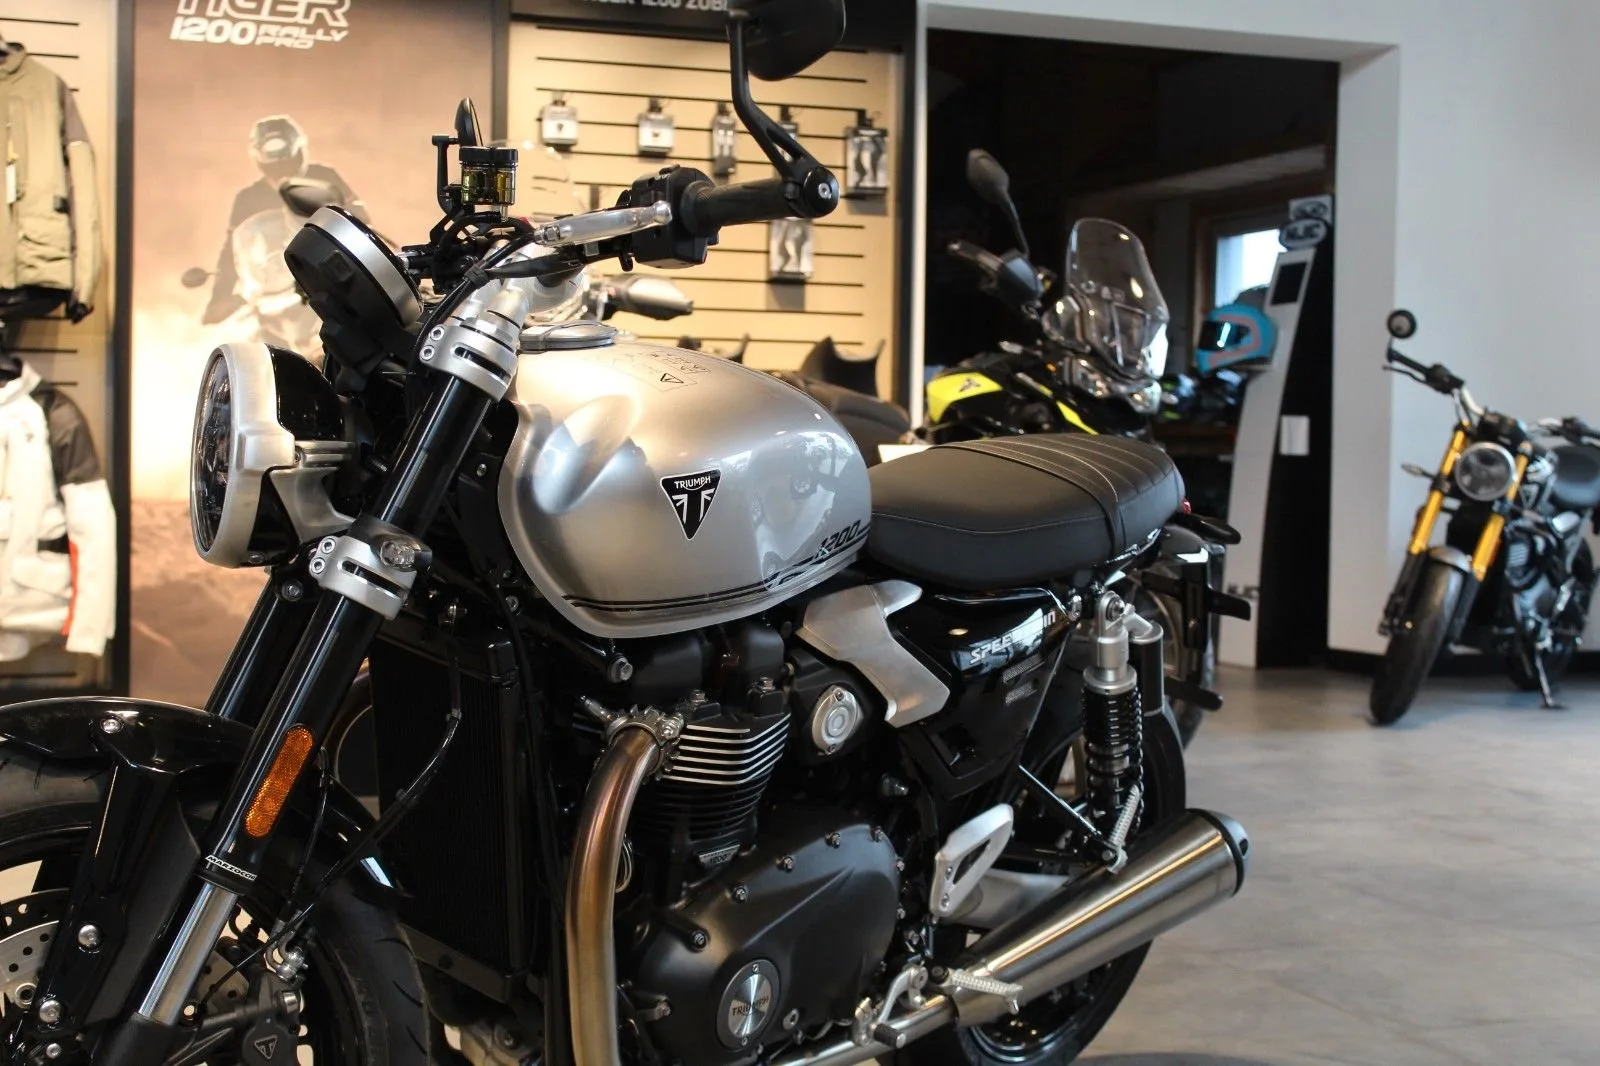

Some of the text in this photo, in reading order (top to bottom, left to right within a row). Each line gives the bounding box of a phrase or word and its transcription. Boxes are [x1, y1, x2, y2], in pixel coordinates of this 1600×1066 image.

[169, 16, 349, 46] 1200 RALLY
[255, 36, 314, 49] PRO
[674, 475, 711, 490] TRIUMPH
